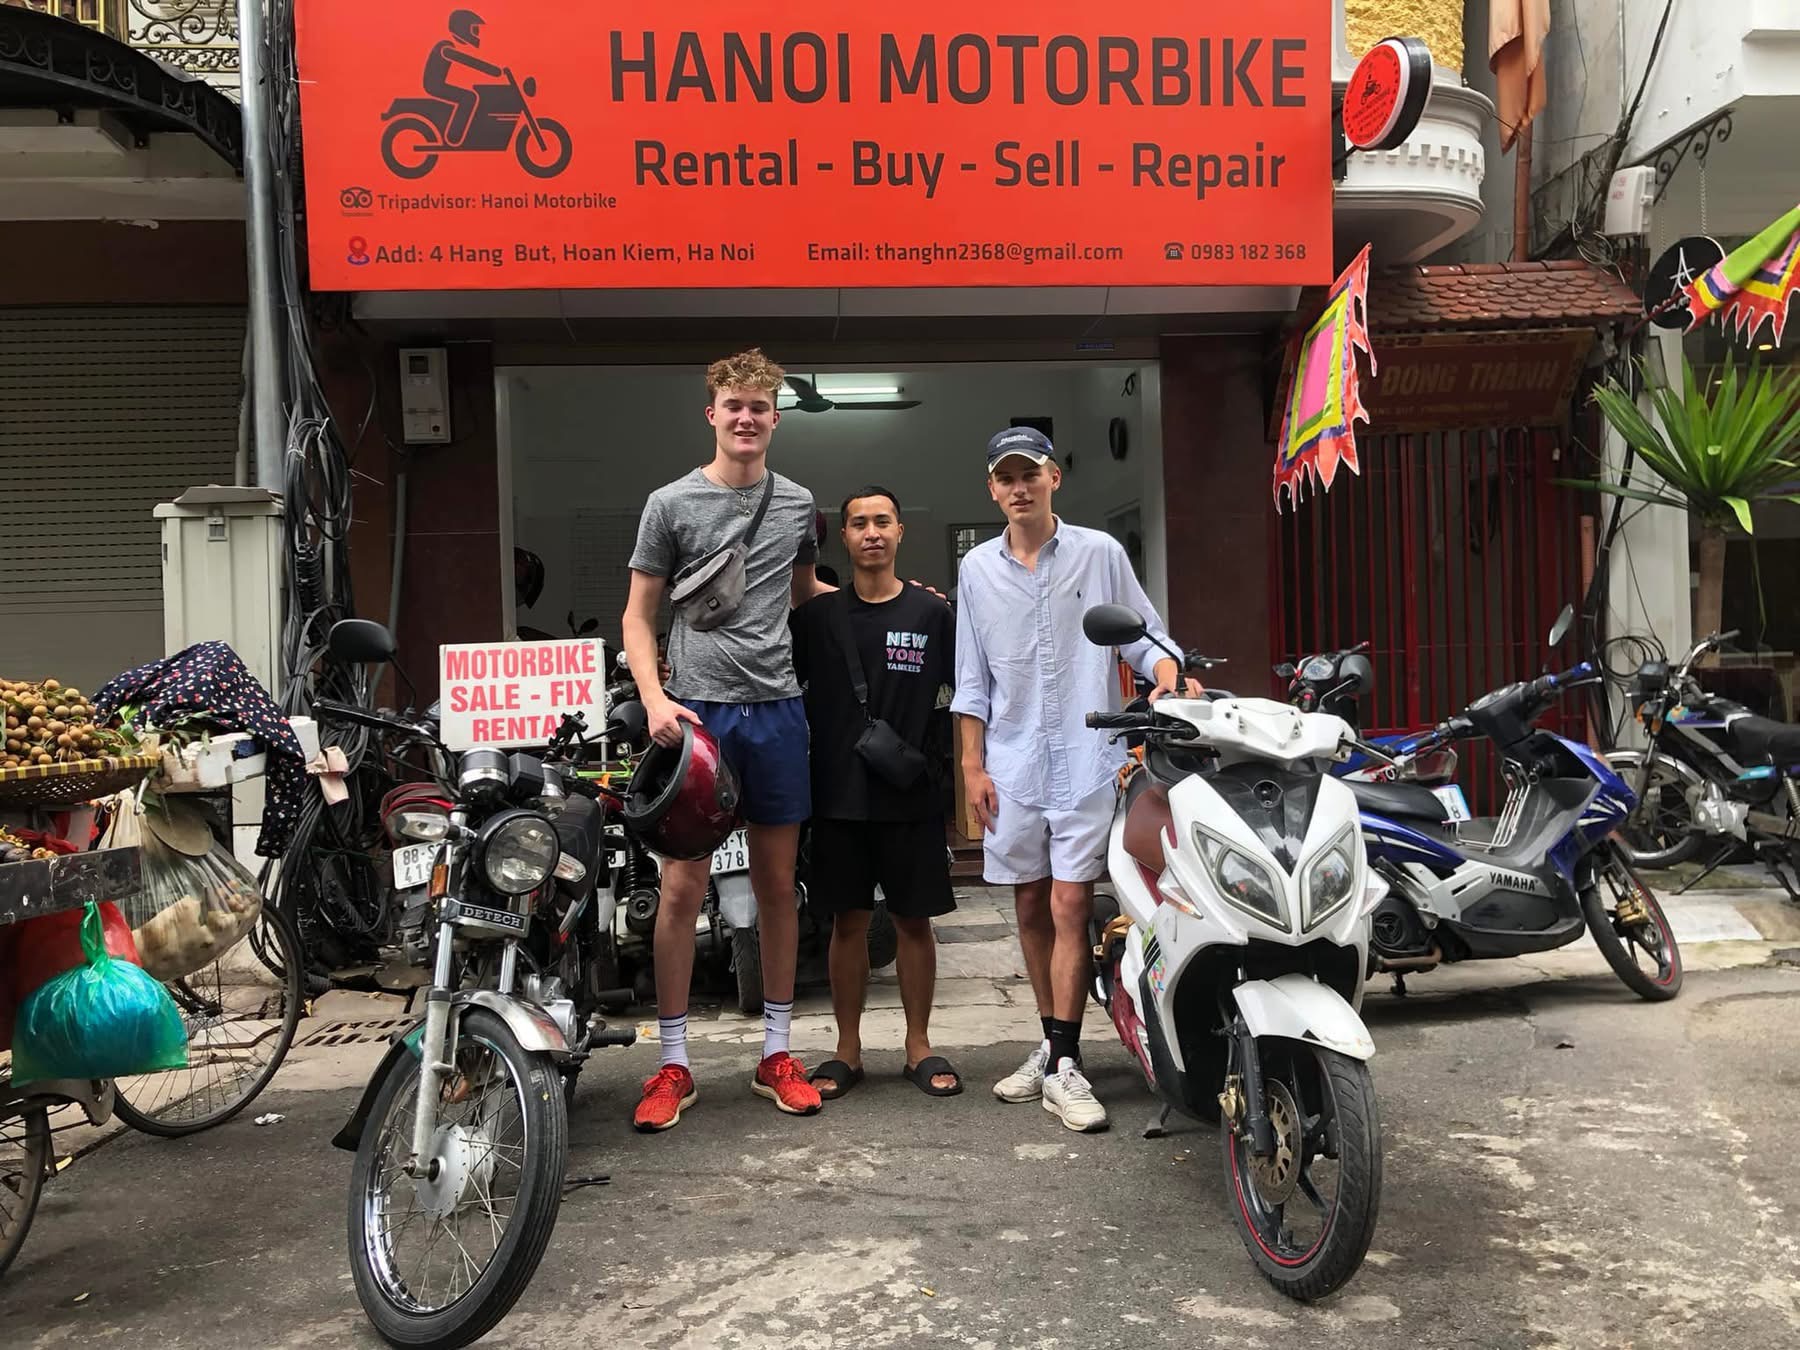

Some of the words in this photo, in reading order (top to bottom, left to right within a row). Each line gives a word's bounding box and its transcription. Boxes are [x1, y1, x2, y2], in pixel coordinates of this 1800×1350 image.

[609, 30, 851, 104] HANOI
[879, 33, 1307, 108] MOTORBIKE
[634, 138, 798, 187] Rental
[852, 140, 945, 199] Buy
[994, 139, 1080, 187] Sell
[1132, 141, 1286, 201] Repair
[377, 193, 477, 214] Tripadvisor:
[480, 193, 529, 209] Hanoi
[533, 192, 617, 209] Motorbike
[375, 244, 423, 264] Add:
[429, 245, 444, 263] 4
[449, 244, 504, 267] Hang
[514, 243, 556, 264] But,
[563, 243, 616, 262] Hoan
[622, 243, 681, 264] Kiem,
[687, 243, 715, 261] Ha
[720, 242, 755, 261] Noi
[807, 242, 870, 261] Email:
[874, 241, 1123, 266] thanghn2368@gmail.com
[1191, 244, 1235, 261] 0983
[1239, 244, 1269, 260] 182
[1274, 243, 1307, 260] 368
[886, 631, 928, 649] NEW
[445, 644, 596, 681] MOTORBIKE
[886, 647, 925, 664] YORK
[450, 682, 521, 713] SALE
[550, 679, 593, 707] FIX
[472, 714, 565, 743] RENTA
[405, 843, 442, 865] 88-S
[713, 850, 745, 871] 378
[1489, 870, 1536, 892] YAMAHA
[463, 906, 521, 927] DETECH
